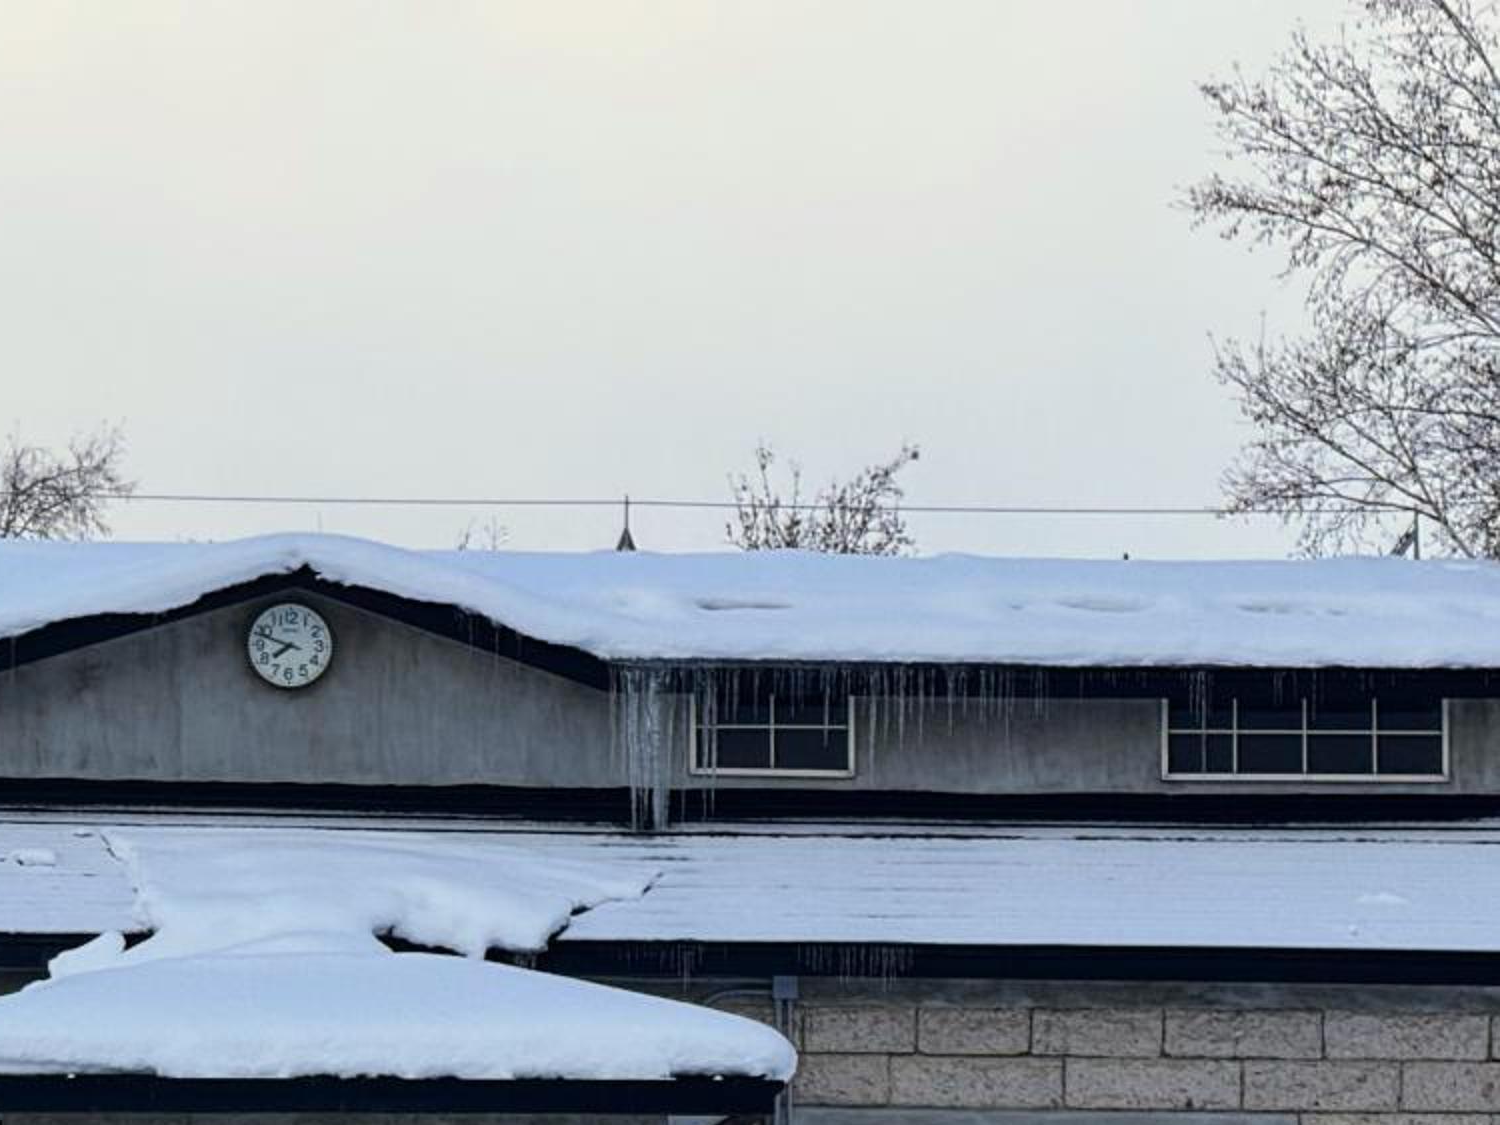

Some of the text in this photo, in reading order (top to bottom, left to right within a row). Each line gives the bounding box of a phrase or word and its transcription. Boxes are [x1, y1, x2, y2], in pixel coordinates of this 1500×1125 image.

[286, 611, 298, 624] 12
[311, 625, 323, 638] 2
[314, 640, 324, 652] 3
[271, 664, 280, 675] 7
[284, 668, 293, 680] 6
[299, 664, 308, 676] 5
